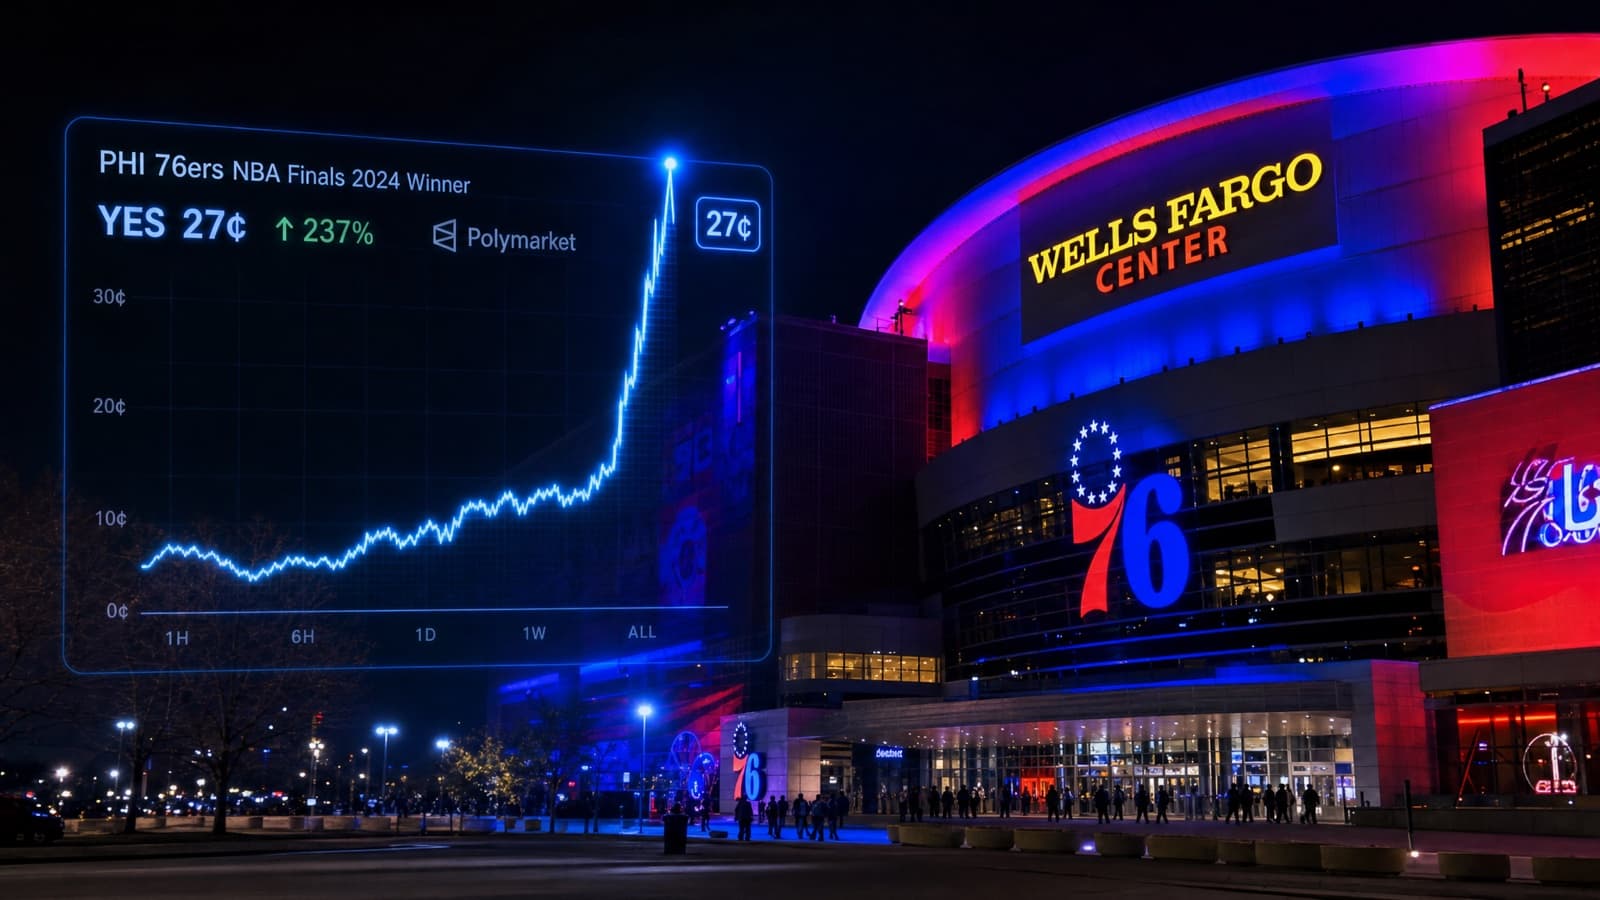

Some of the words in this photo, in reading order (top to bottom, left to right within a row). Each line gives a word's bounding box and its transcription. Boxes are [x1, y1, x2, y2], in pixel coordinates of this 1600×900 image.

[1028, 206, 1158, 285] WELLS
[1166, 152, 1323, 234] FARGO
[1095, 225, 1228, 293] CENTER
[1072, 473, 1191, 617] 76
[732, 753, 761, 801] 76
